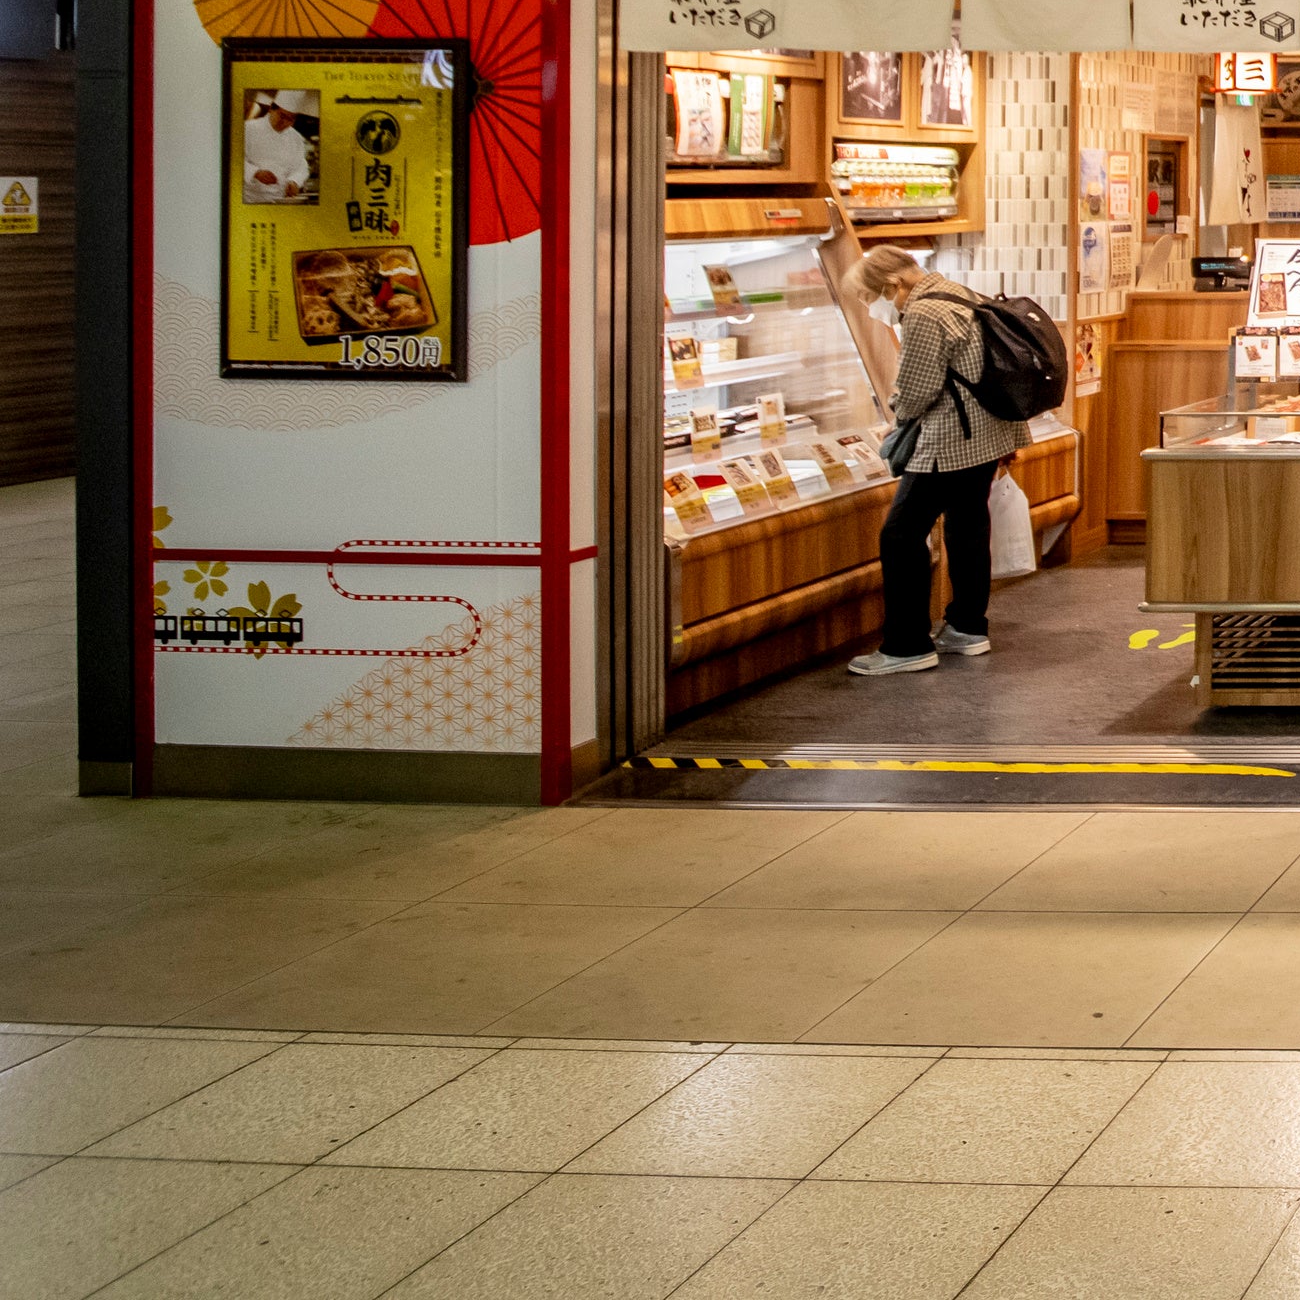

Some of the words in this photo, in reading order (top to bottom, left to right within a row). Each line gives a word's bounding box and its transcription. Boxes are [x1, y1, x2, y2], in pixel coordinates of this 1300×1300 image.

[669, 8, 741, 27] いただき
[1181, 9, 1256, 28] いただき
[1244, 59, 1265, 82] 三
[365, 157, 392, 233] 肉三昧
[338, 335, 441, 370] 1,850円
